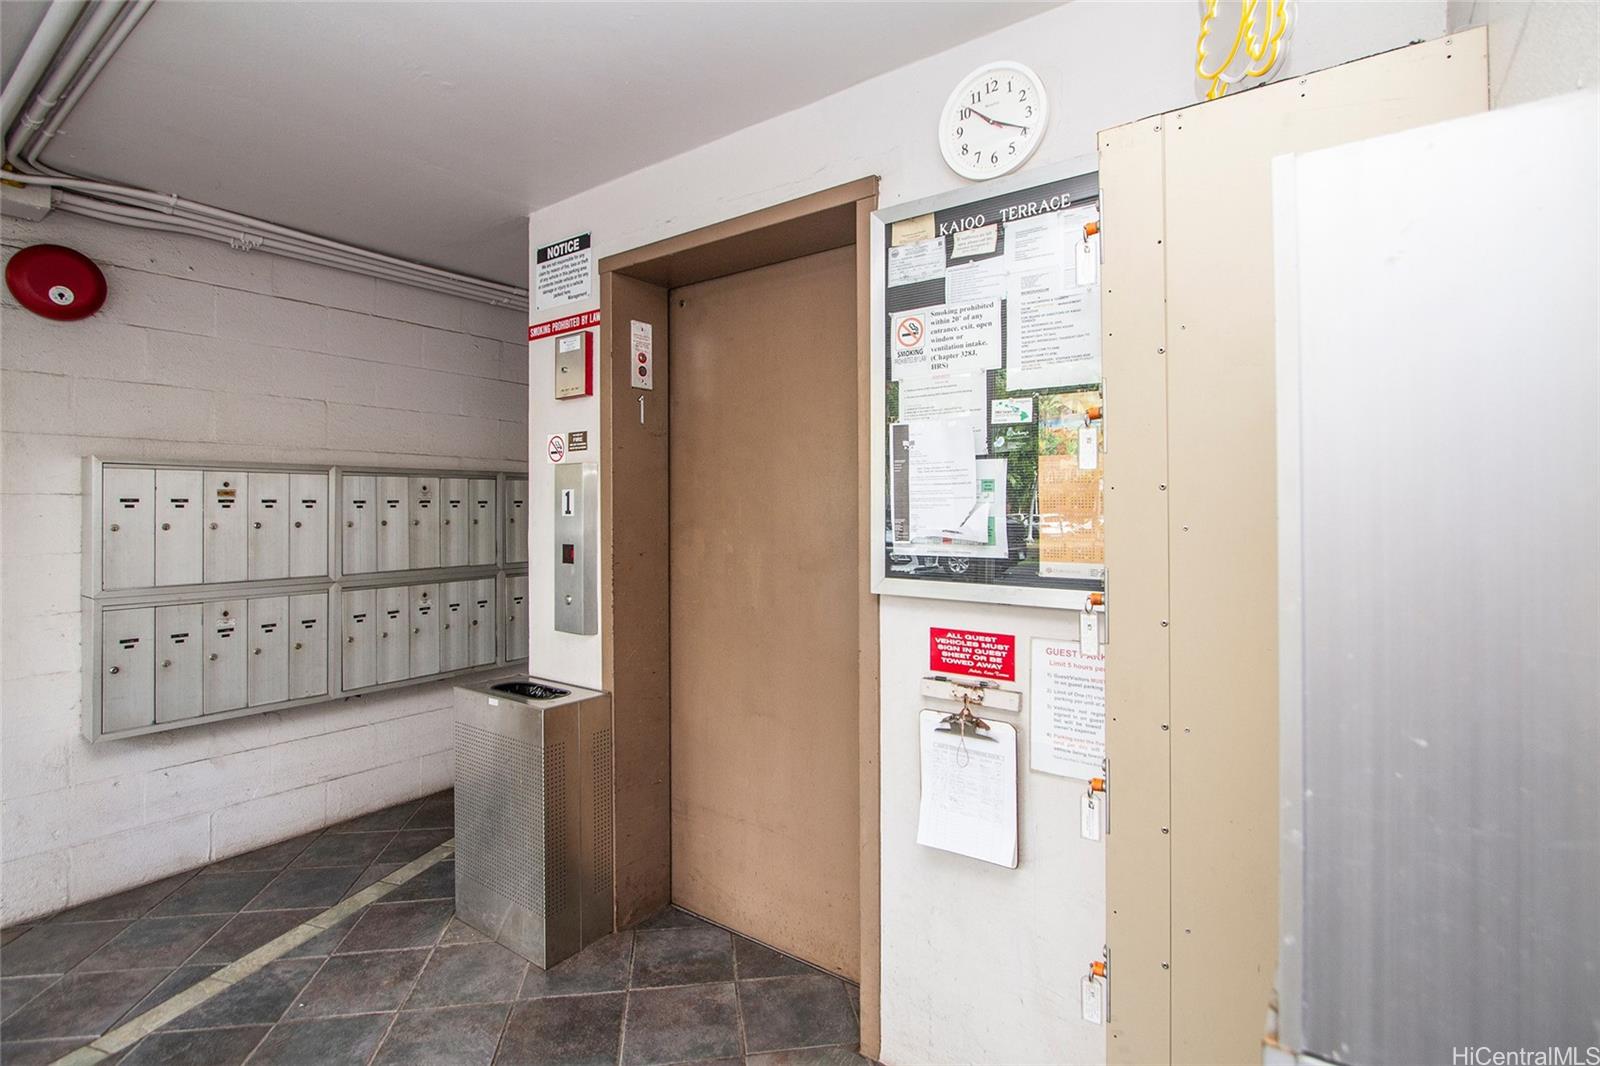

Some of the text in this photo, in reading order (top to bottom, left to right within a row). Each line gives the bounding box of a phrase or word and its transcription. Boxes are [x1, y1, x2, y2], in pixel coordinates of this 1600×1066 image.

[985, 80, 998, 94] 12
[1008, 81, 1011, 92] 1
[971, 91, 981, 104] 11
[1019, 90, 1026, 102] 2
[960, 107, 971, 121] 10
[1025, 106, 1032, 118] 3
[957, 127, 963, 139] 9
[962, 144, 968, 155] 8
[1009, 141, 1015, 155] 5
[975, 152, 981, 163] 7
[991, 152, 998, 164] 6
[940, 214, 985, 236] KAIOO
[1000, 193, 1071, 223] TERRACE
[547, 238, 580, 259] NOTICE
[568, 291, 587, 300] Management
[931, 301, 994, 317] Smoking prohibited
[530, 311, 600, 337] SMOKING PROHIBITED BY LAW
[931, 318, 950, 326] within
[931, 326, 959, 335] entrance,
[976, 322, 992, 330] open
[898, 348, 923, 358] SMOKING
[931, 344, 964, 353] ventilation
[931, 353, 959, 362] (Chapter
[638, 395, 644, 424] 1
[565, 491, 571, 514] 1
[935, 637, 979, 647] VEHICLES
[965, 634, 997, 642] GUEST
[942, 651, 970, 659] SHEET
[974, 649, 1007, 657] GUEST
[1046, 647, 1077, 657] GUEST
[941, 657, 974, 666] TOWED
[1054, 734, 1072, 742] Parking
